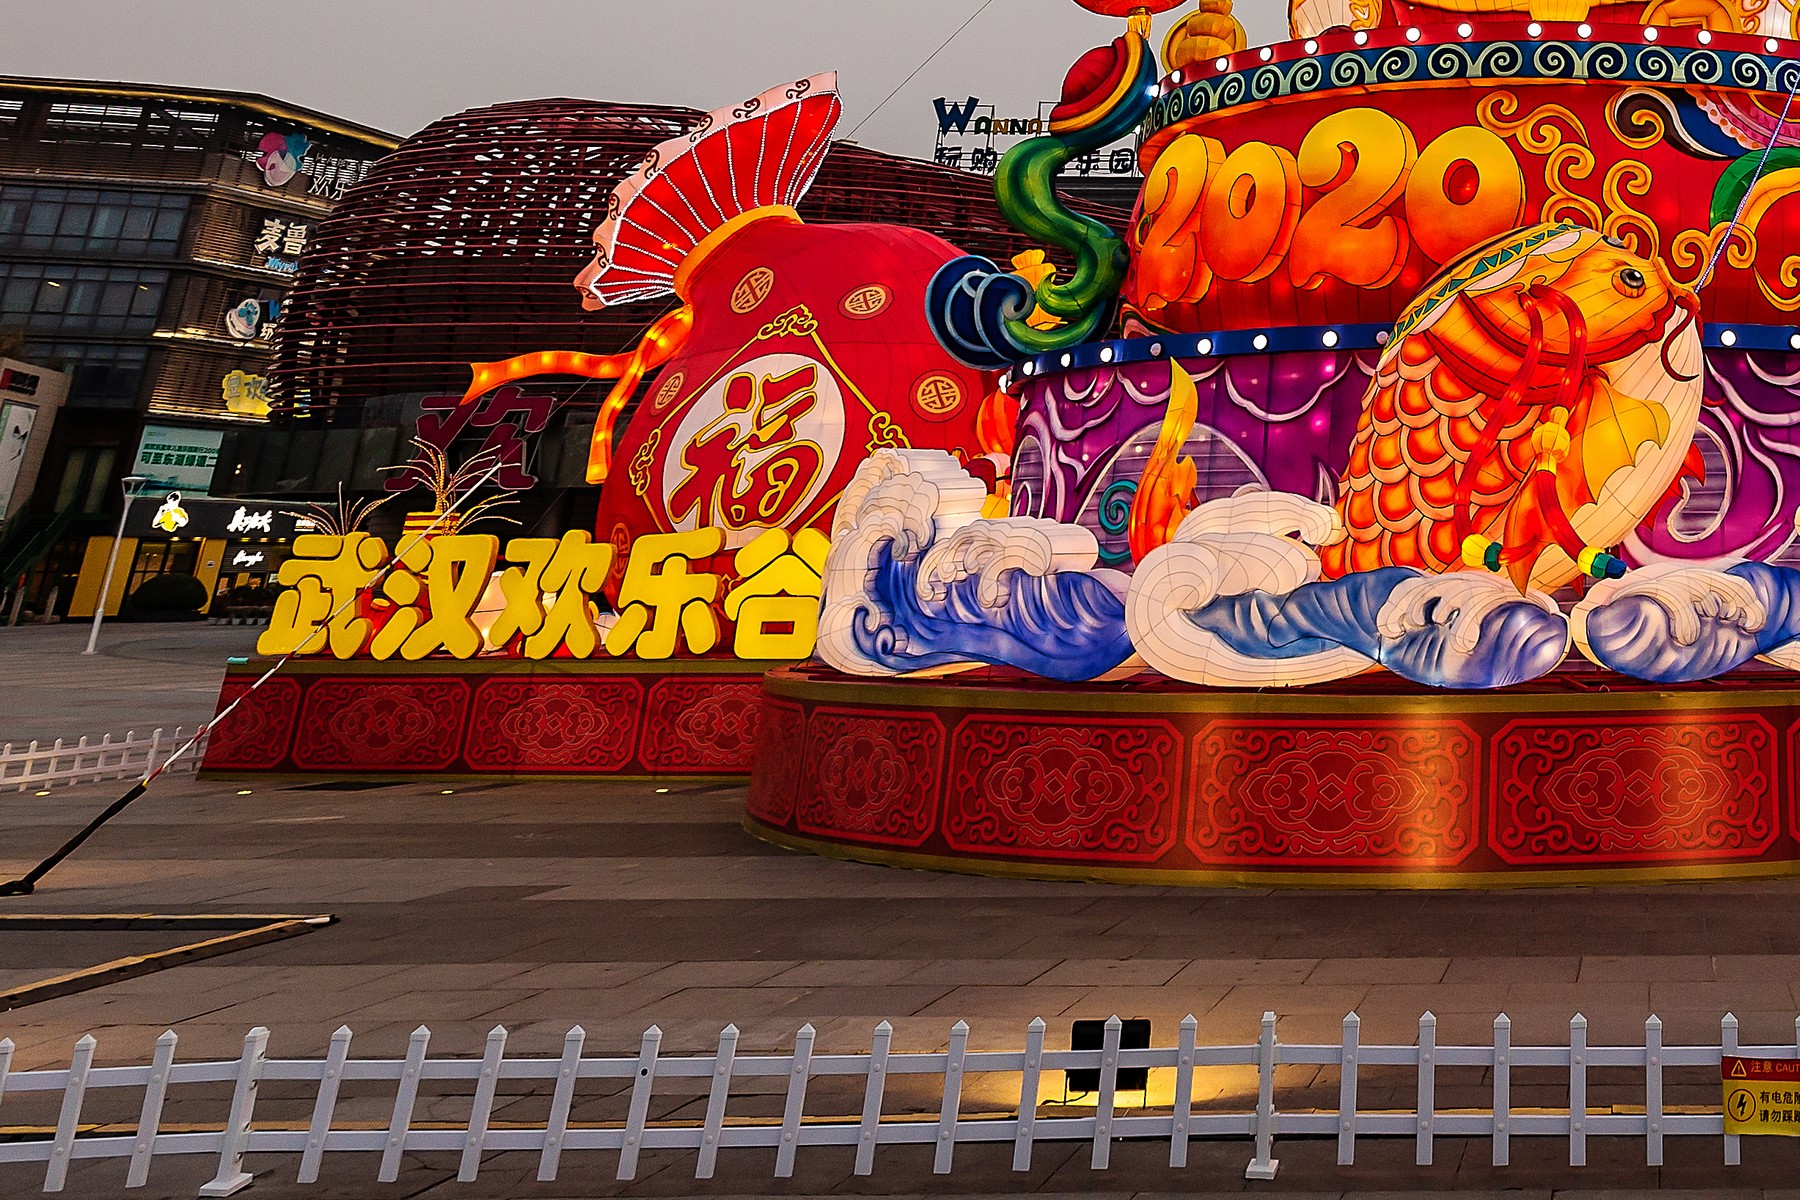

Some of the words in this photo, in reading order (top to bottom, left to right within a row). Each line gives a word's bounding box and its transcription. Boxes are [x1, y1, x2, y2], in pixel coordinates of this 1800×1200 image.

[1137, 107, 1526, 311] 2020
[668, 363, 825, 531] 福
[257, 527, 831, 661] 武汉欢乐谷
[1751, 1060, 1773, 1073] 注意
